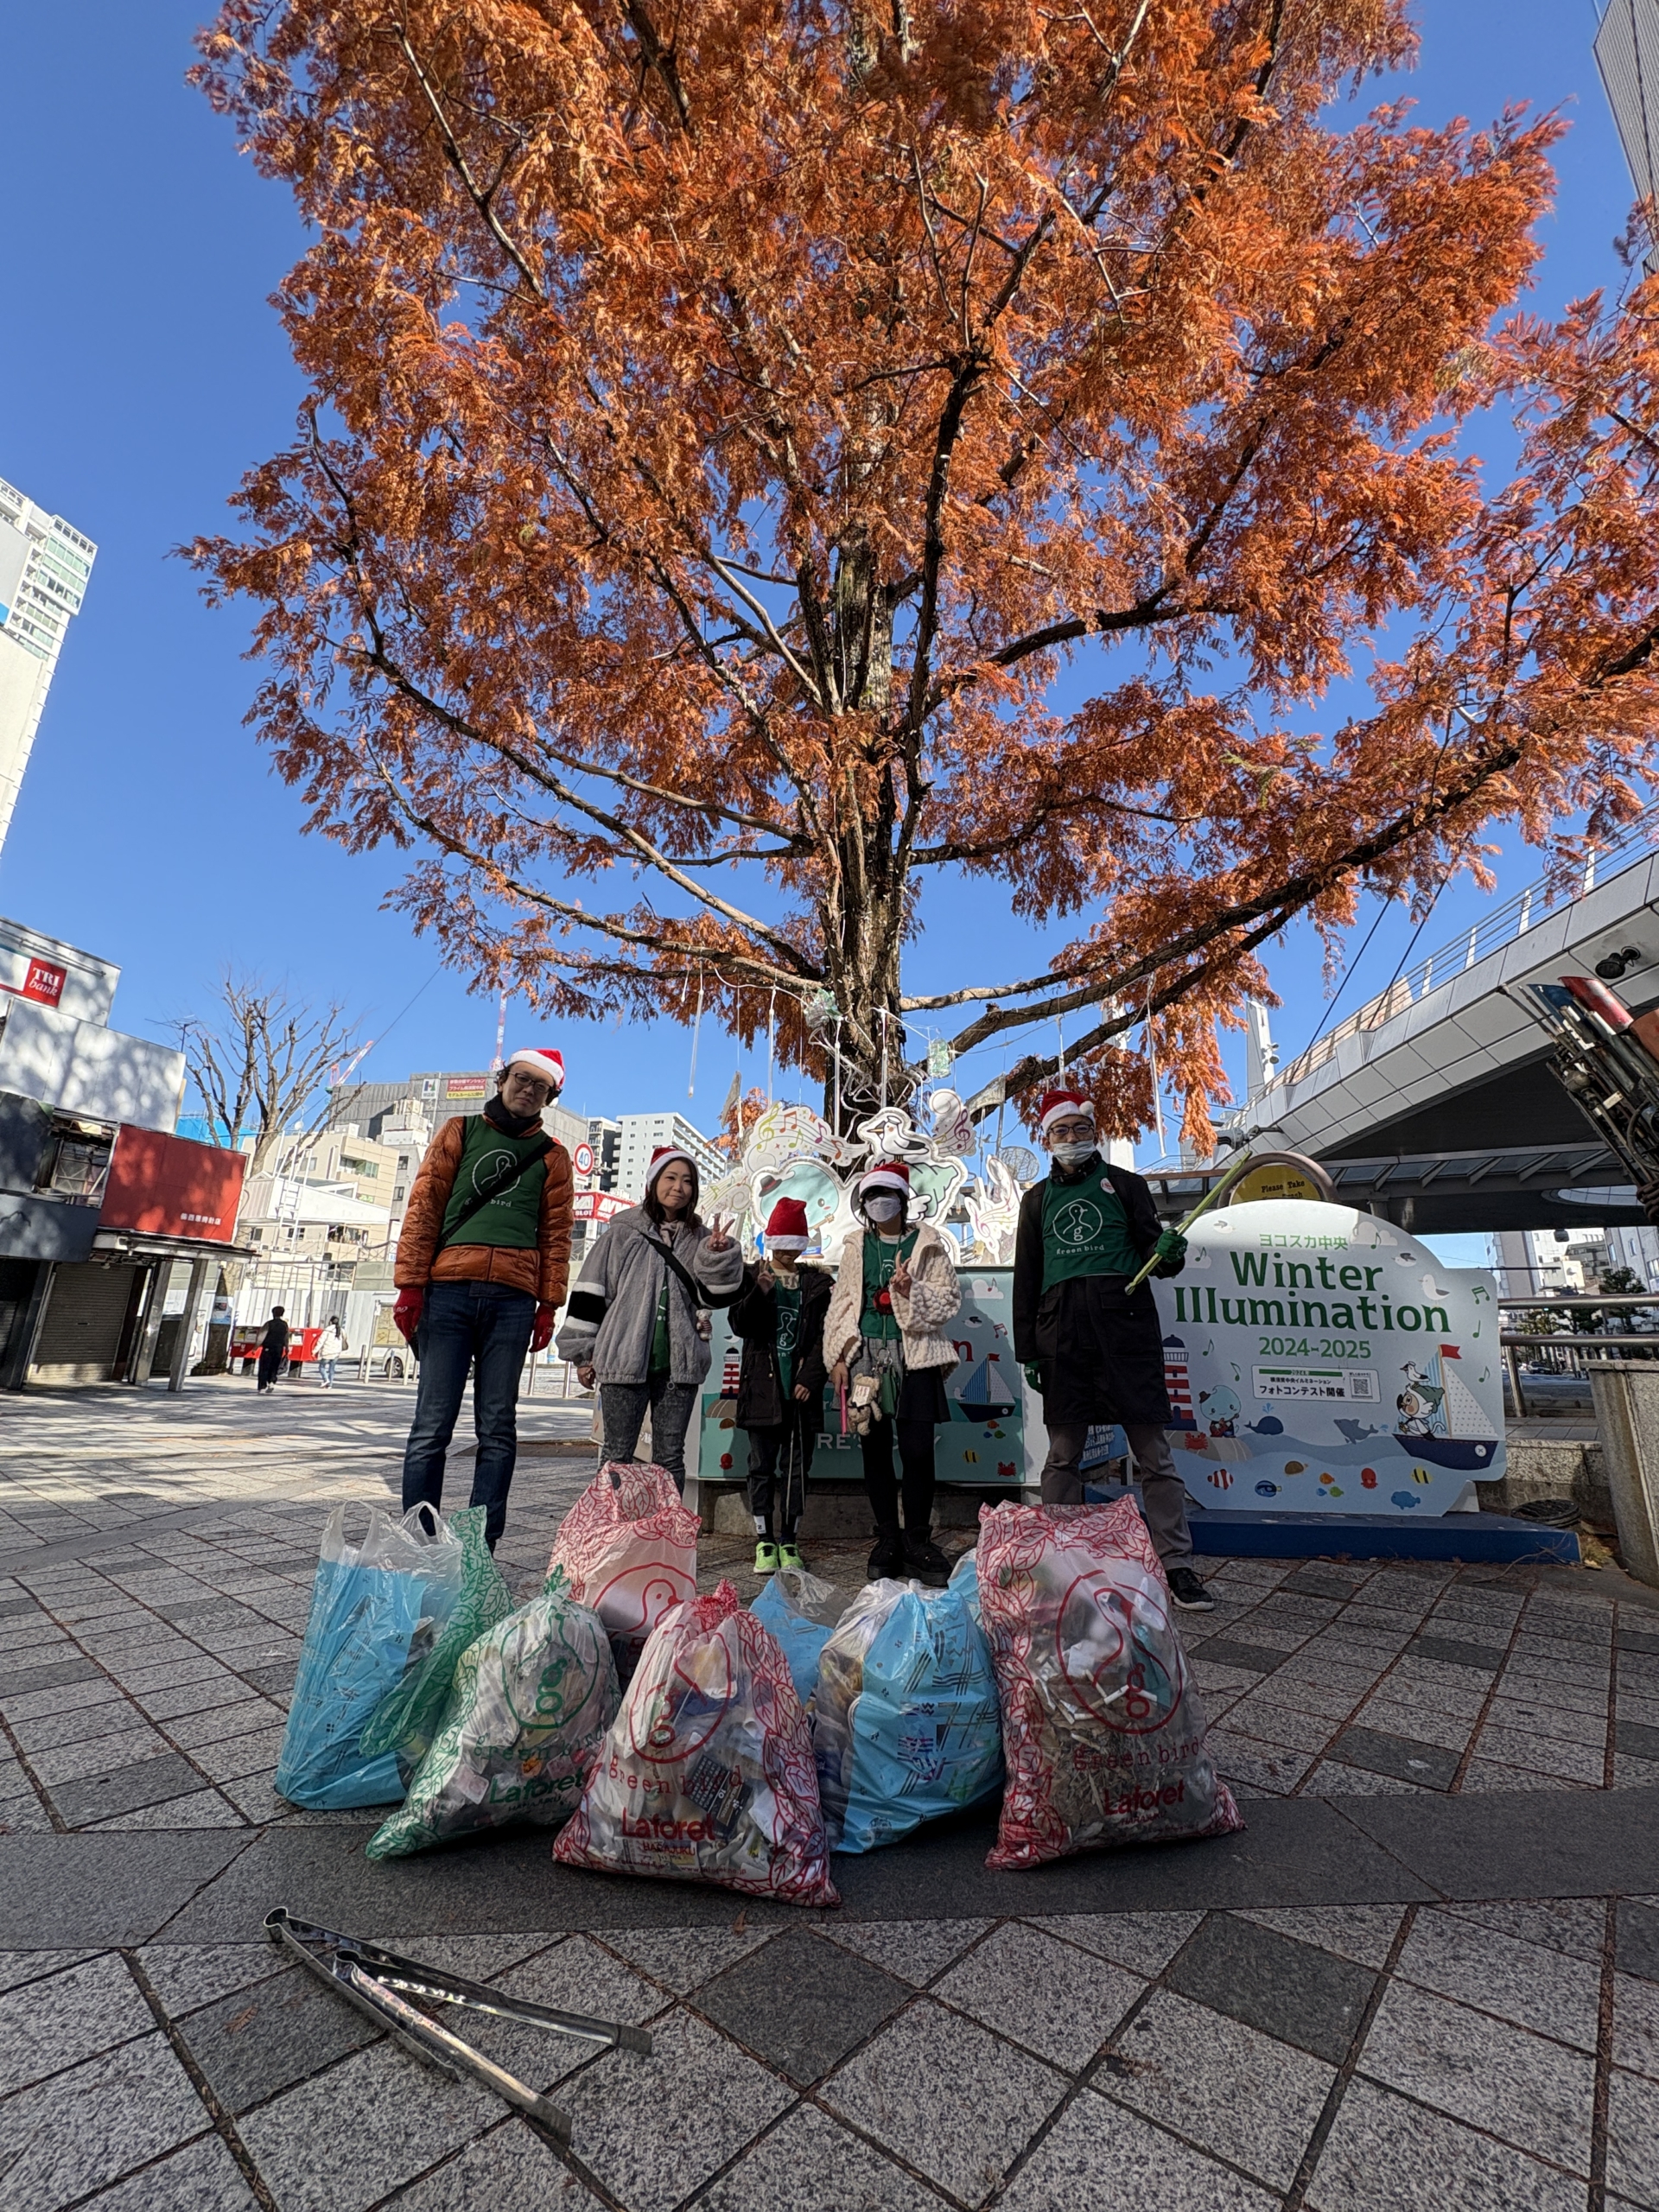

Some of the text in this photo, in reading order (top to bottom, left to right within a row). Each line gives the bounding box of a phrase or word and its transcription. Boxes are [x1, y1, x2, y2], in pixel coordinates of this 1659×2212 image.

[29, 976, 59, 996] bank
[32, 966, 60, 988] TRI
[578, 1152, 590, 1166] 40
[1261, 1184, 1284, 1192] Please
[490, 1198, 512, 1208] bird
[1073, 1225, 1084, 1242] g
[1259, 1234, 1349, 1250] ヨコスカ中央
[1056, 1247, 1082, 1255] green
[1229, 1251, 1383, 1291] Winter
[1173, 1287, 1452, 1332] Illumination
[1259, 1337, 1371, 1359] 2024-2025
[1259, 1385, 1346, 1397] フォトコンテスト開催
[535, 1657, 568, 1714] g
[1125, 1662, 1150, 1719] g
[474, 1724, 604, 1761] green bird
[1073, 1736, 1200, 1771] green bird
[489, 1767, 584, 1804] Laforet
[608, 1754, 673, 1795] green
[679, 1765, 743, 1796] bird
[1103, 1779, 1185, 1816] Laforet
[621, 1807, 716, 1842] Laforet
